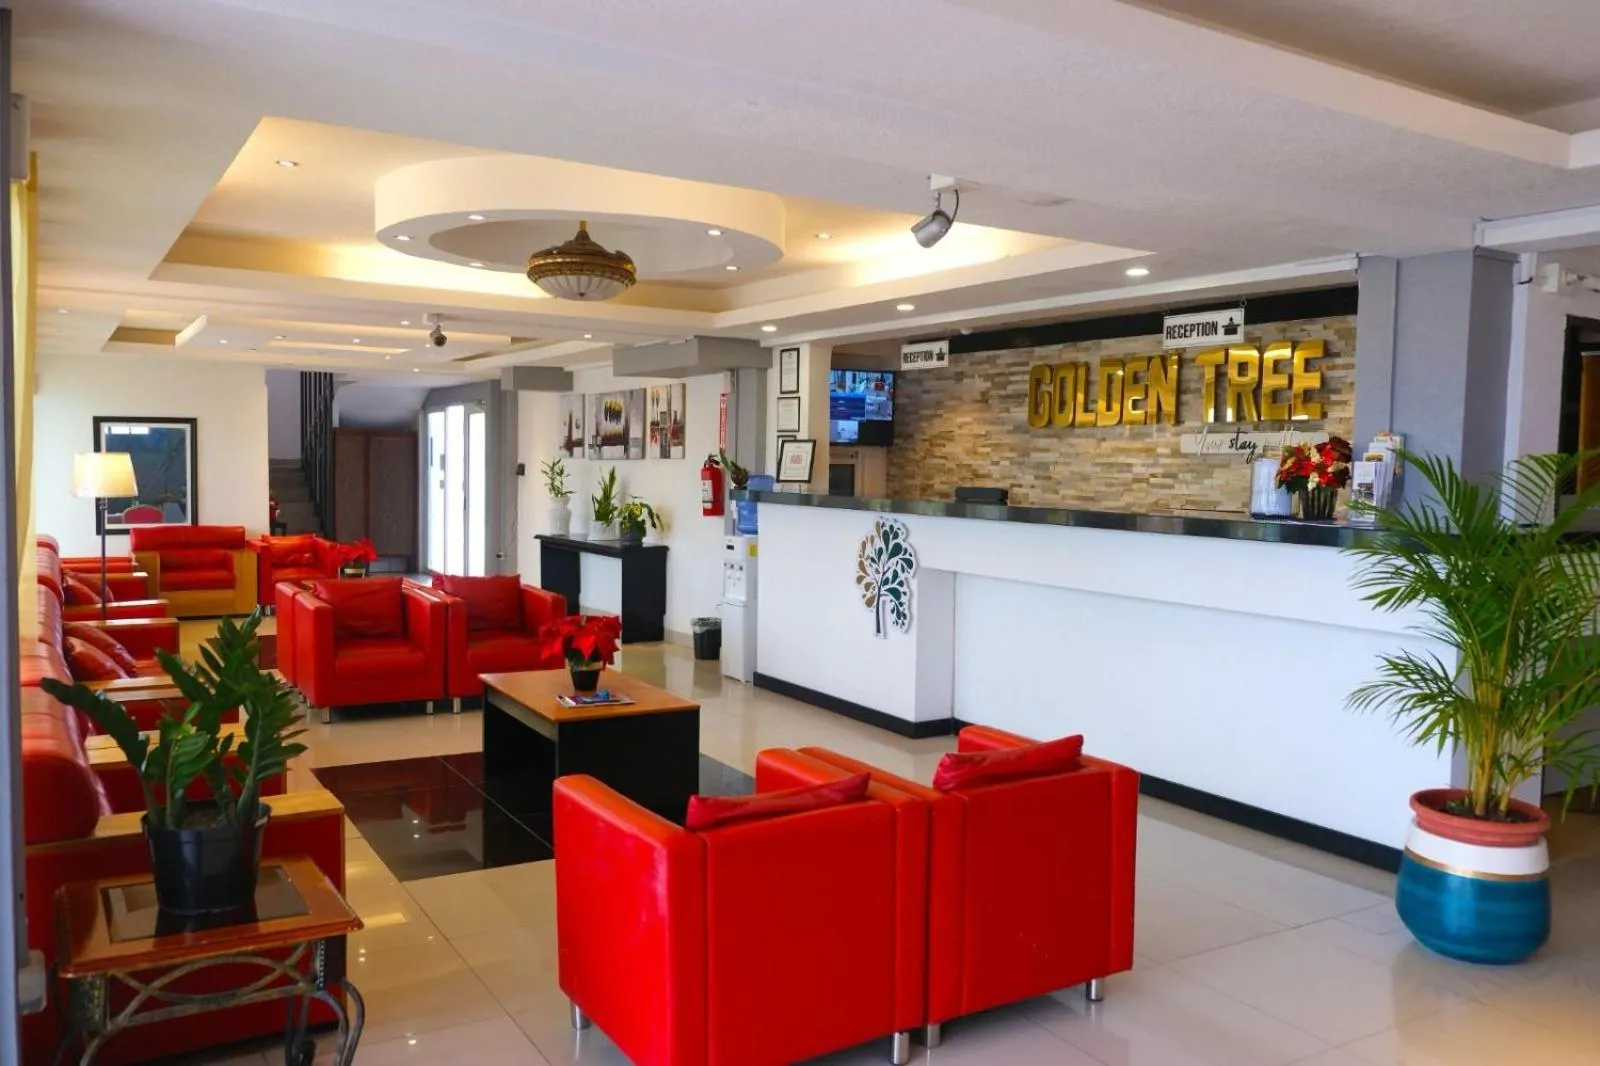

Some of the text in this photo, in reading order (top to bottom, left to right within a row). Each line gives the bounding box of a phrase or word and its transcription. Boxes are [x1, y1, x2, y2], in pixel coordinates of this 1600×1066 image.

[1165, 320, 1218, 340] RECEPTION
[903, 350, 934, 364] RECEPTION
[1028, 339, 1326, 428] GOLDEN TREE
[1228, 427, 1258, 464] stay
